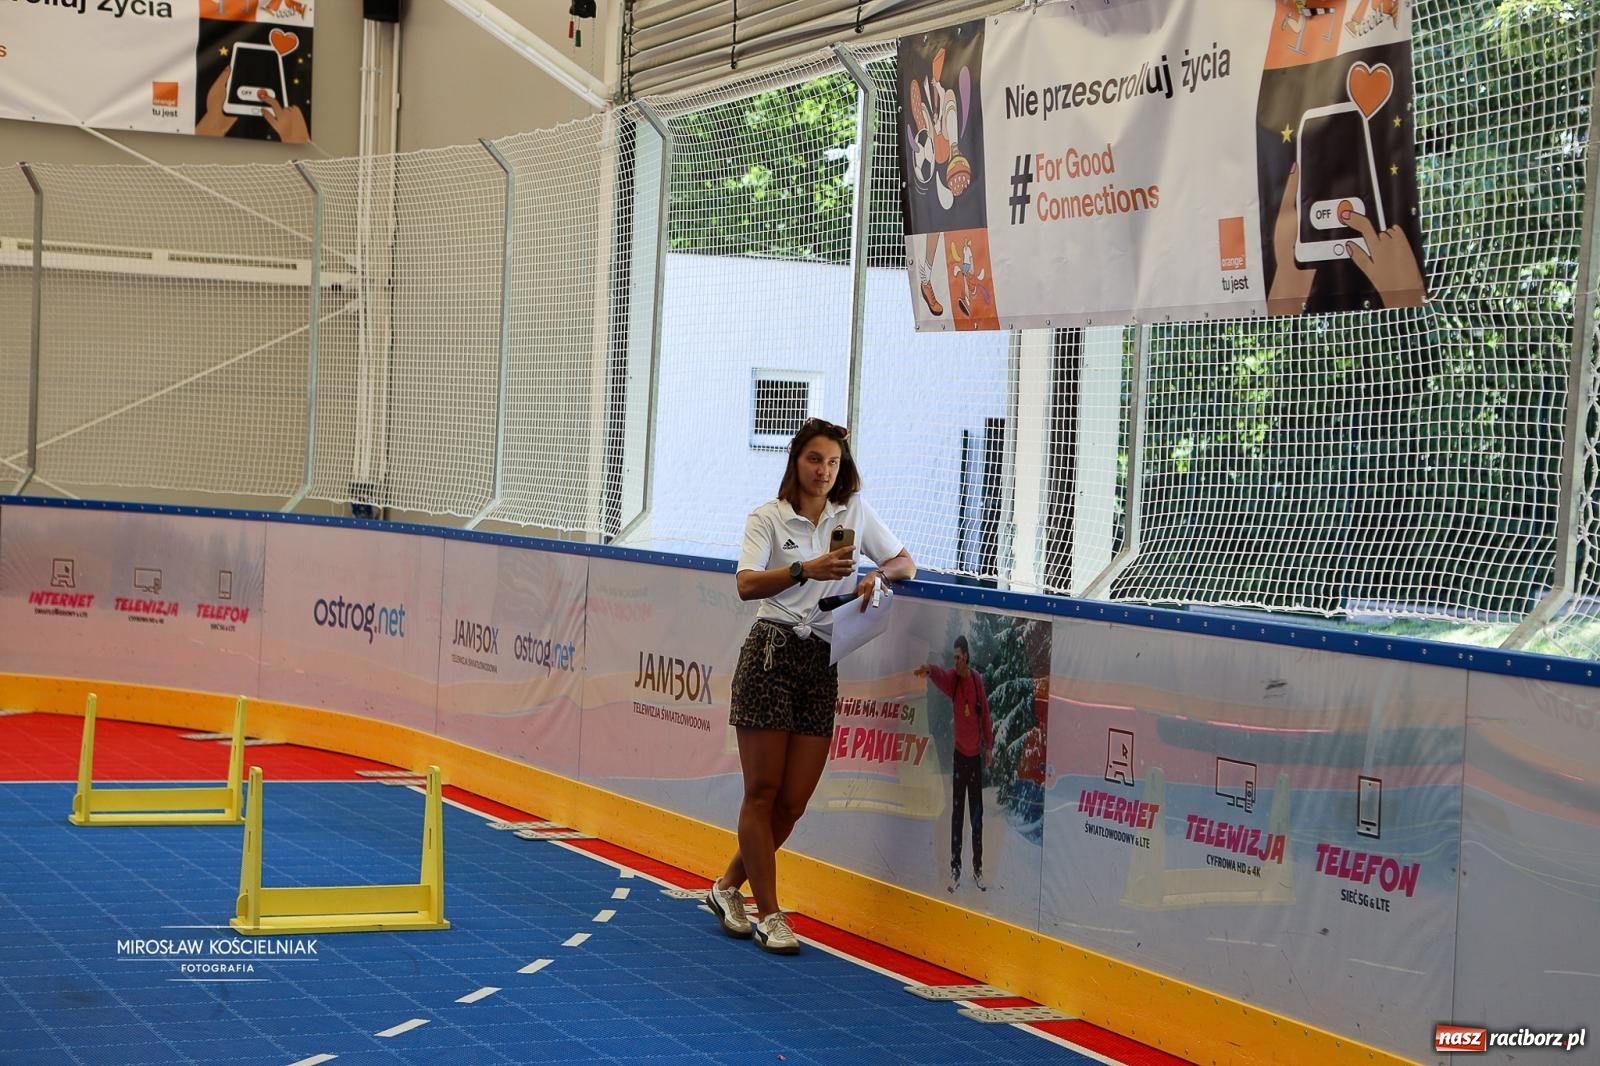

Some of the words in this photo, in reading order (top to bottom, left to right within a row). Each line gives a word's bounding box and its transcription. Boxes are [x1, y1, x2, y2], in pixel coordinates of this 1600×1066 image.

[1005, 84, 1038, 119] Nie
[1043, 55, 1174, 120] przescrolluj
[1181, 42, 1231, 93] życia
[152, 108, 161, 116] tu
[162, 108, 178, 117] jest
[1065, 143, 1116, 178] Good
[1037, 183, 1160, 221] Connections
[1315, 209, 1332, 220] OFF
[1222, 255, 1244, 269] orange
[28, 591, 96, 609] INTERNET
[115, 597, 180, 617] TELEWIZJA
[196, 603, 250, 624] TELEFON
[313, 595, 406, 644] ostrog.net
[513, 632, 576, 677] ostrog.net
[633, 701, 661, 719] TELEWIZJA
[881, 702, 901, 719] ALE
[851, 727, 930, 766] PAKIETY
[1078, 789, 1160, 830] INTERNET
[1140, 836, 1151, 849] LTE
[1186, 814, 1286, 865] TELEWIZJA
[1206, 854, 1236, 872] CYFROWA
[1237, 861, 1247, 874] HD
[1252, 866, 1261, 878] 4K
[1315, 843, 1421, 898] TELEFON
[1341, 888, 1358, 905] SIEĆ
[1358, 892, 1369, 907] 5G
[1375, 897, 1391, 913] LTE
